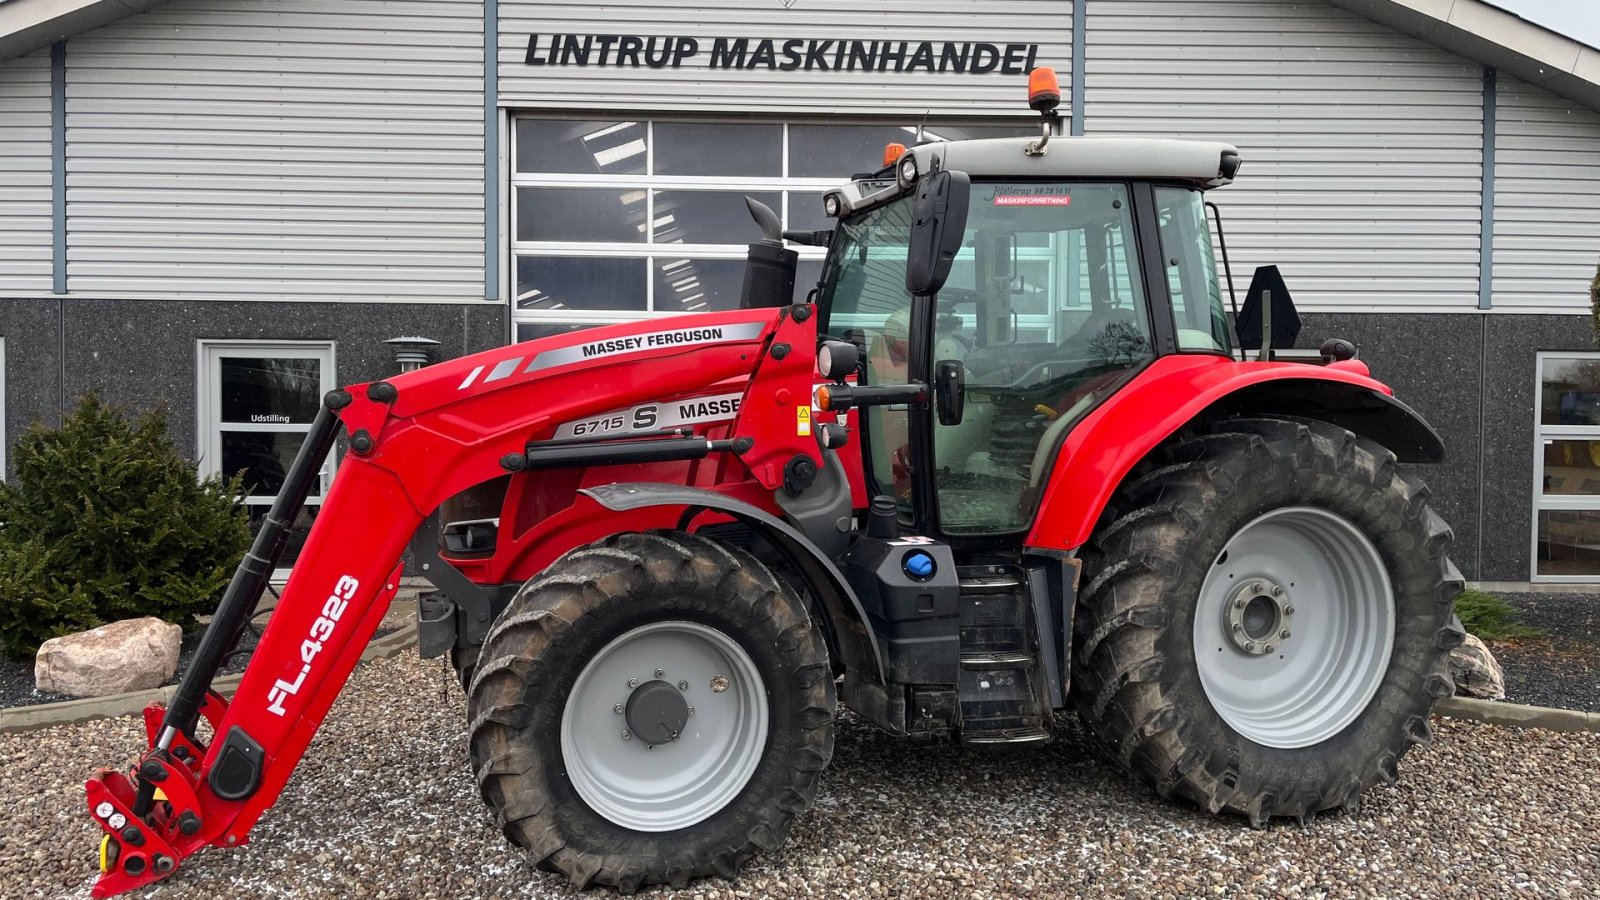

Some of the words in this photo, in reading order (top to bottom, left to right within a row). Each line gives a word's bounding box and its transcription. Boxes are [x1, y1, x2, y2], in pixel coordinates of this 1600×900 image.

[525, 33, 699, 69] LINTRUP
[709, 37, 1038, 75] MASKINHANDEL
[997, 197, 1069, 205] MASKINFORRETNING
[582, 336, 643, 357] MASSEY
[647, 328, 723, 347] FERGUSON
[250, 414, 290, 424] Udstilling
[573, 416, 624, 436] 6715
[632, 405, 658, 430] S
[266, 574, 359, 717] FL.4323
